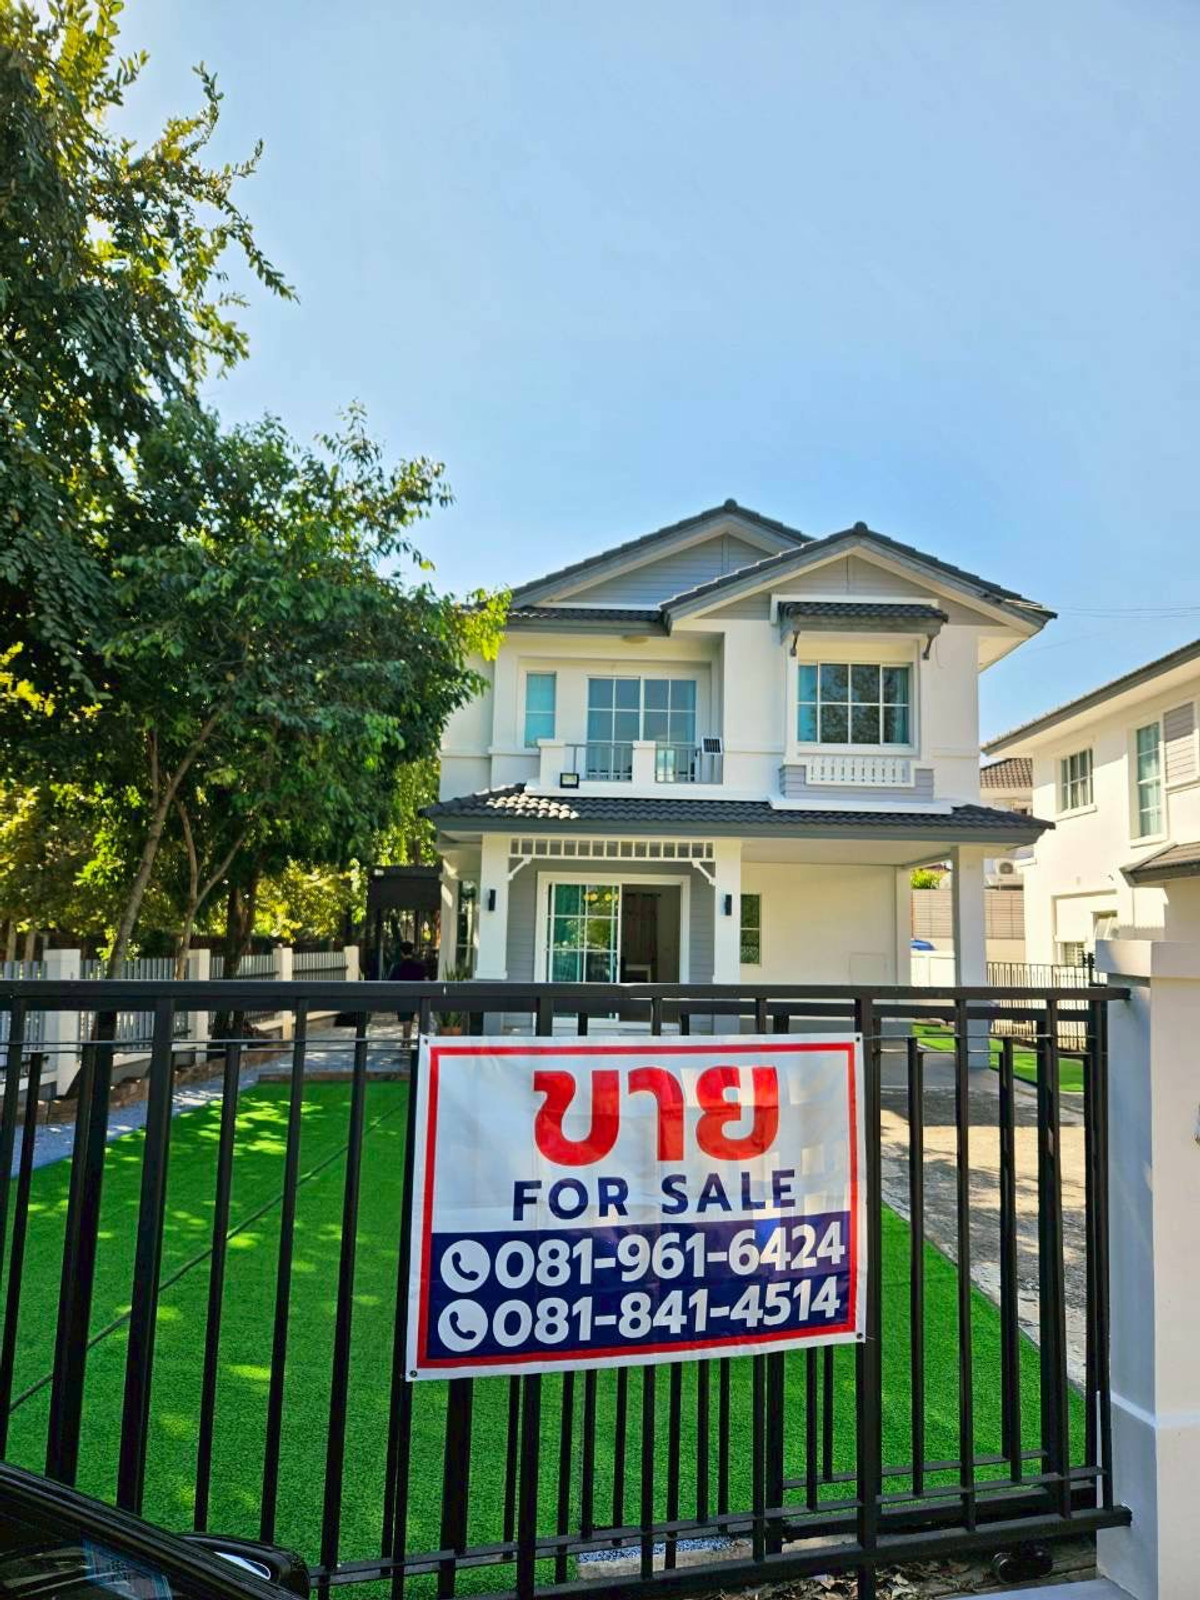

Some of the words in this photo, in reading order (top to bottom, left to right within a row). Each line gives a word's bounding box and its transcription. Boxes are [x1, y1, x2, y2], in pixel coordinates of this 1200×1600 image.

[533, 1065, 779, 1166] ขาย
[512, 1177, 629, 1222] FOR
[661, 1169, 796, 1215] SALE
[495, 1221, 845, 1289] 081-961-6424
[493, 1276, 840, 1348] 081-841-4514
